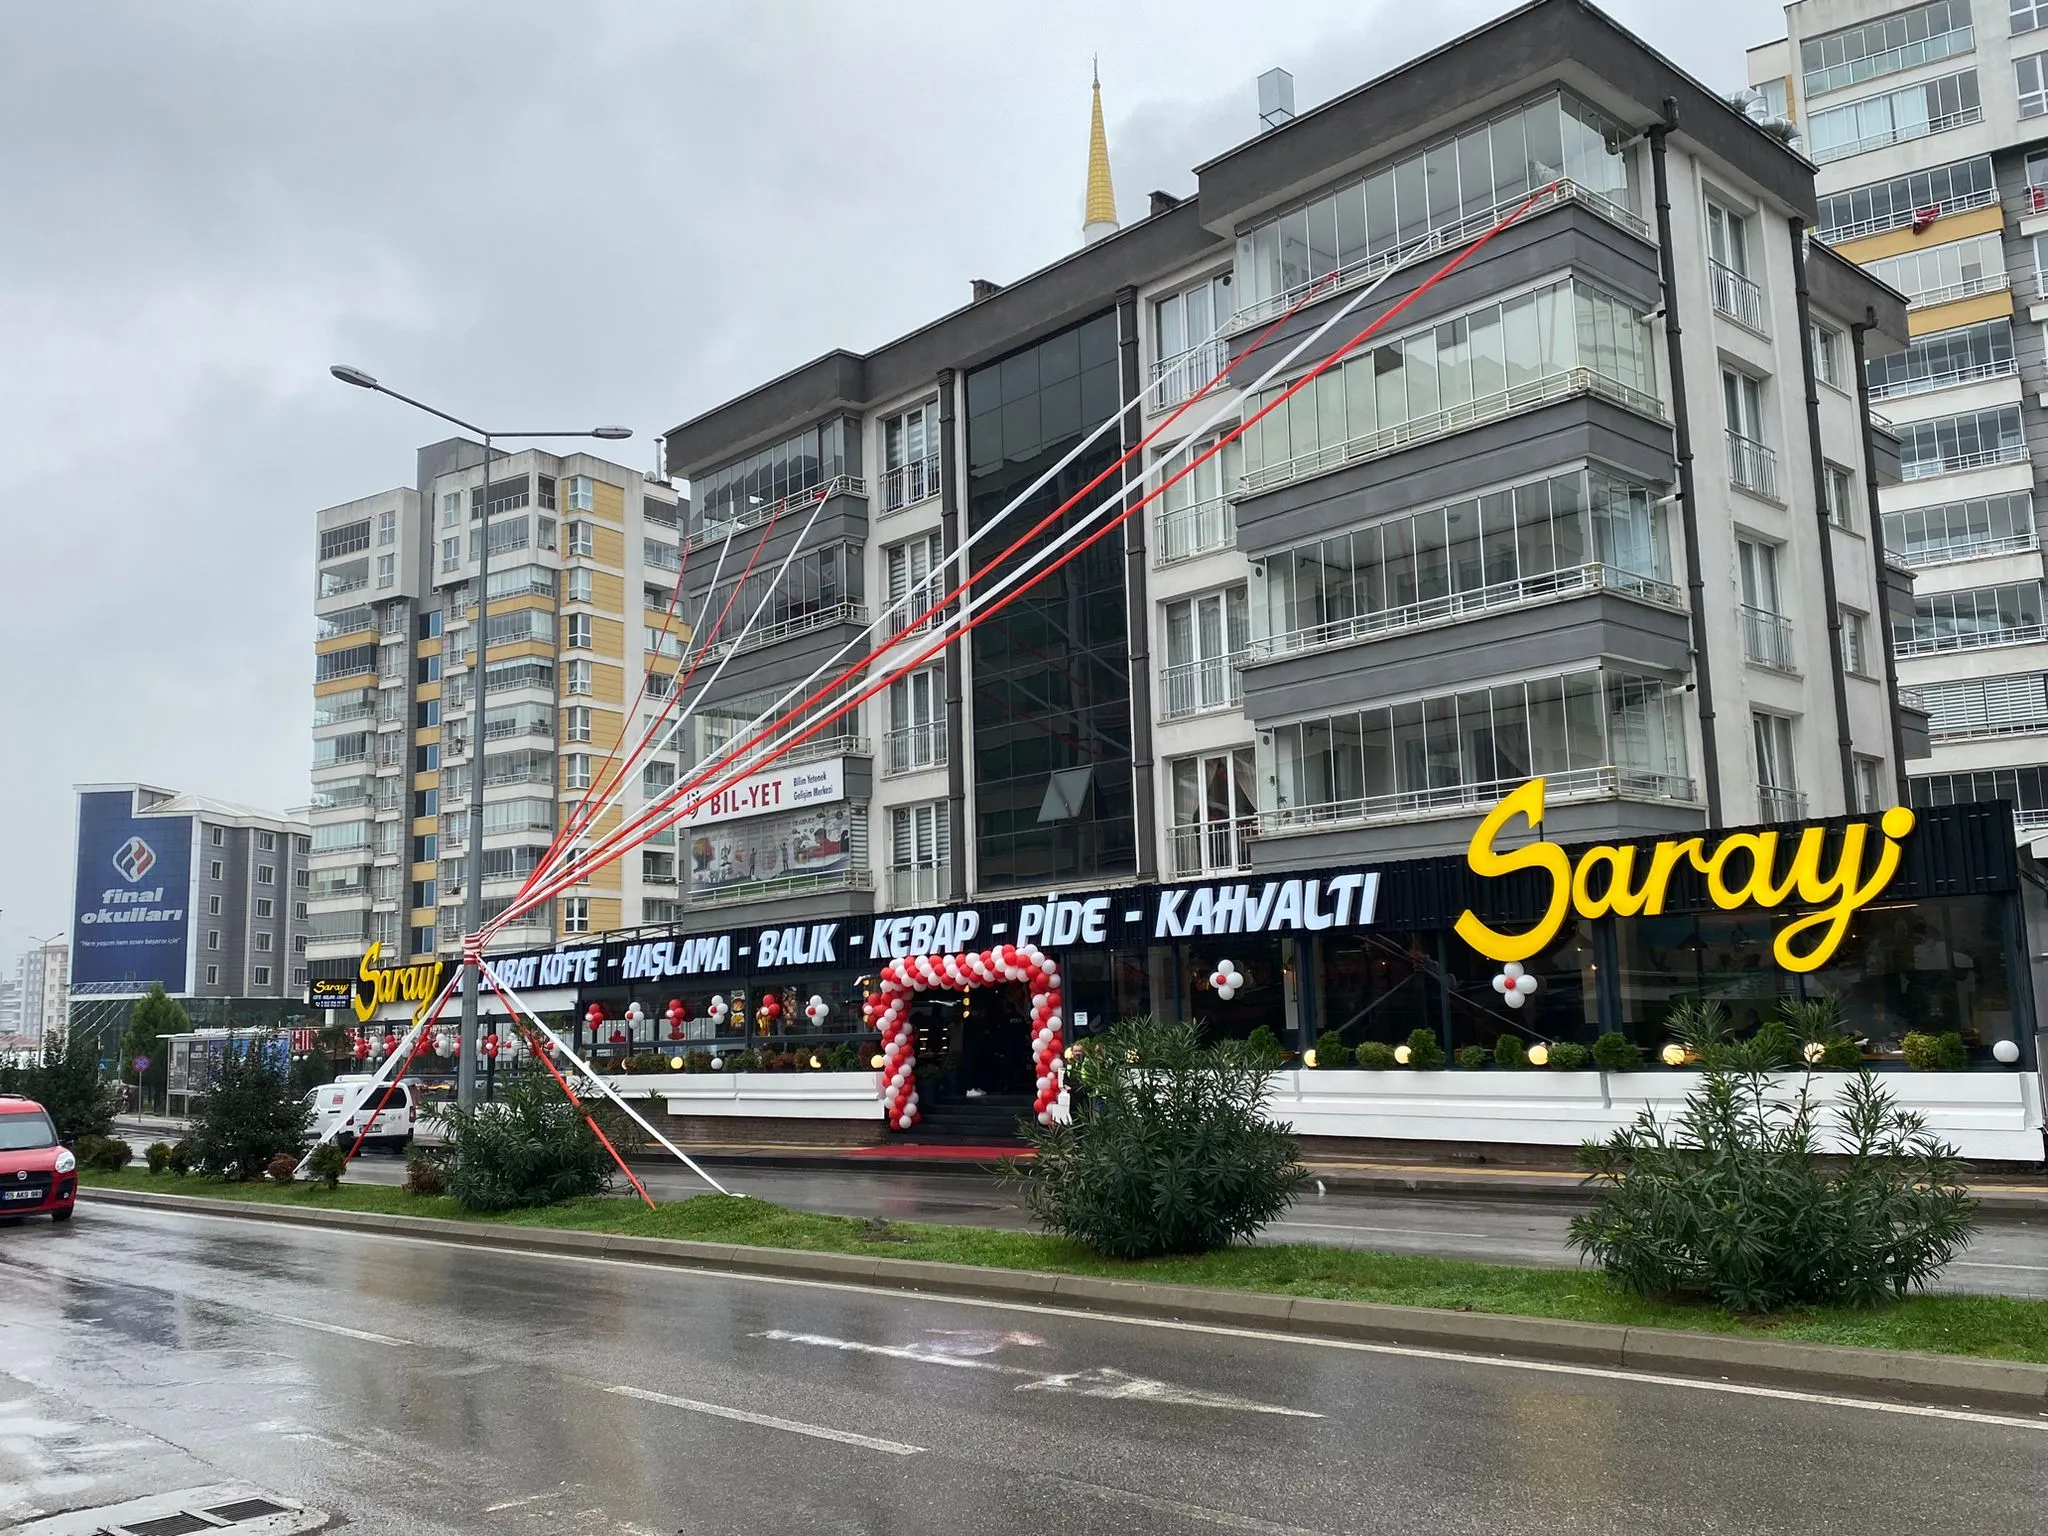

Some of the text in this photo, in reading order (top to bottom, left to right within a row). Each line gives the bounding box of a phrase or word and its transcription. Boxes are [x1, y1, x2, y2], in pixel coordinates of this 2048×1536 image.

[102, 887, 164, 904] final
[80, 907, 183, 925] okulları
[538, 944, 602, 986] KÖFTE
[622, 935, 731, 982] HAŞLAMA
[757, 923, 840, 968] BALIK
[869, 909, 980, 959] KEBAP
[1016, 891, 1112, 949] PİDE
[1154, 872, 1382, 938] KAHVALTI
